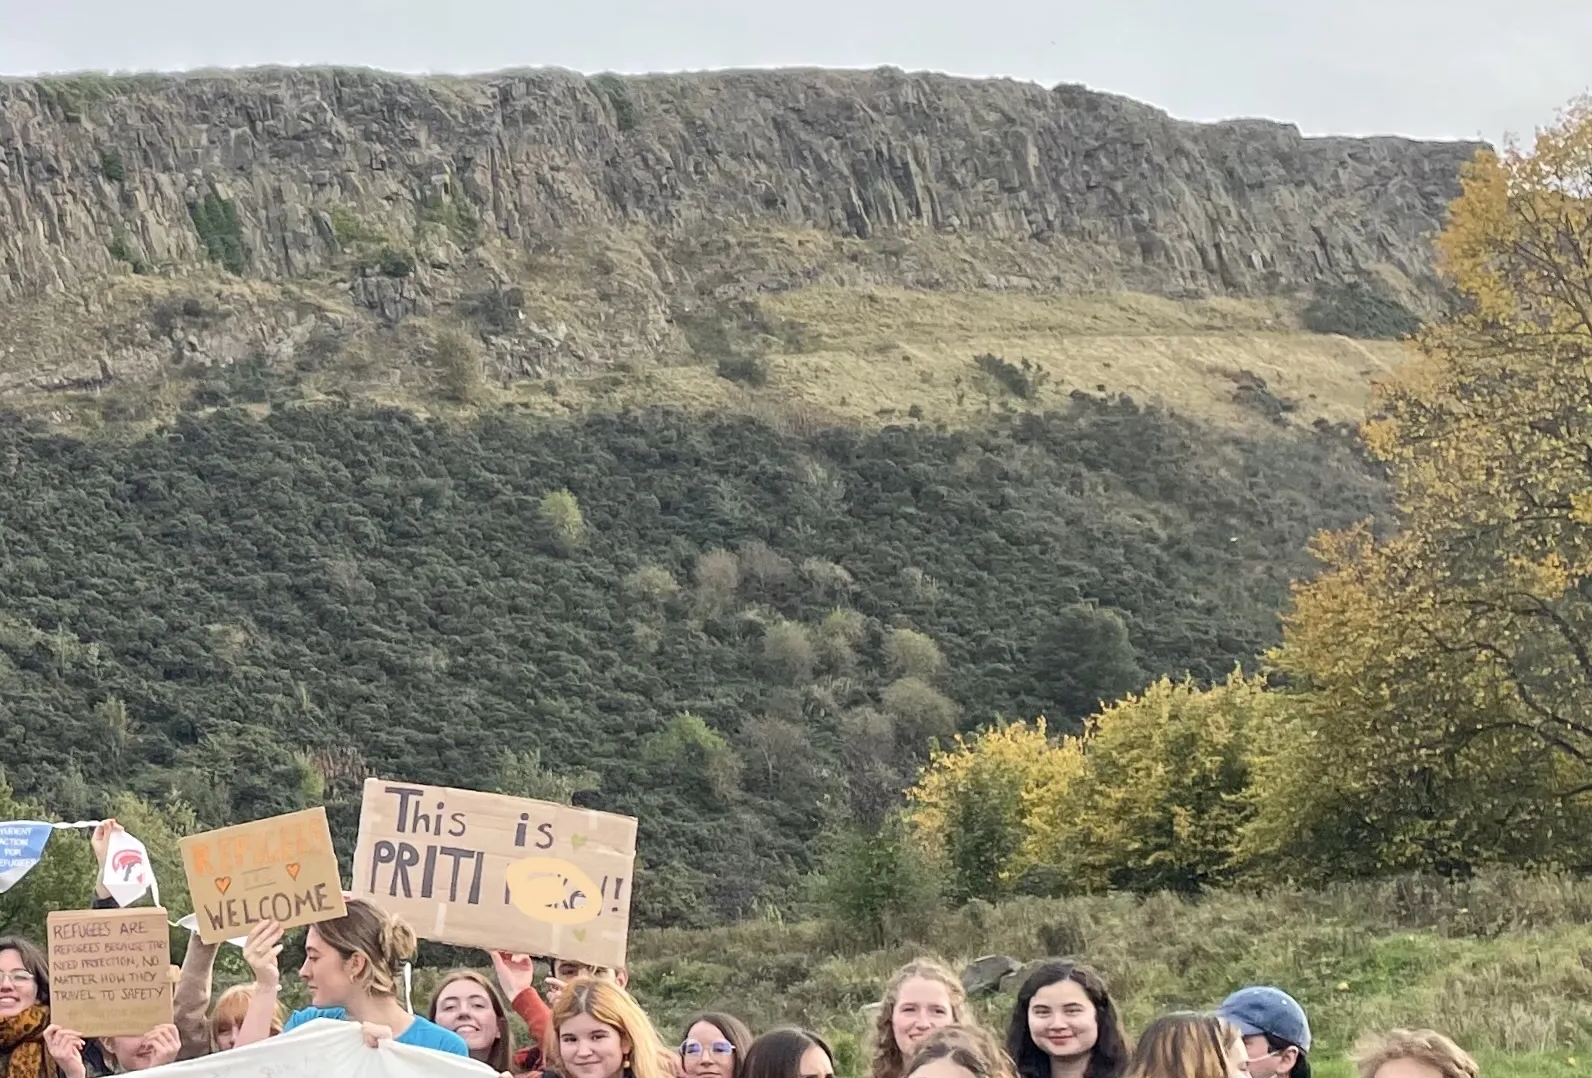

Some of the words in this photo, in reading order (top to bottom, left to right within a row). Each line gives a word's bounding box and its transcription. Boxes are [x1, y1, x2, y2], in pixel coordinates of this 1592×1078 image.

[385, 786, 466, 837] This
[514, 812, 554, 849] is
[4, 848, 21, 856] FOR
[370, 840, 485, 905] PRITI
[203, 882, 335, 931] WELCOME
[53, 921, 111, 939] REFUGEES
[120, 921, 149, 936] ARE
[53, 943, 101, 955] REFUGEES
[53, 960, 78, 971] NEED
[142, 955, 160, 967] NO
[53, 973, 98, 986] MATTER
[100, 972, 126, 984] HOW
[129, 971, 158, 983] THEY
[53, 989, 97, 1001] TRAVEL
[101, 988, 115, 1001] TO
[120, 986, 165, 1001] SAFETY
